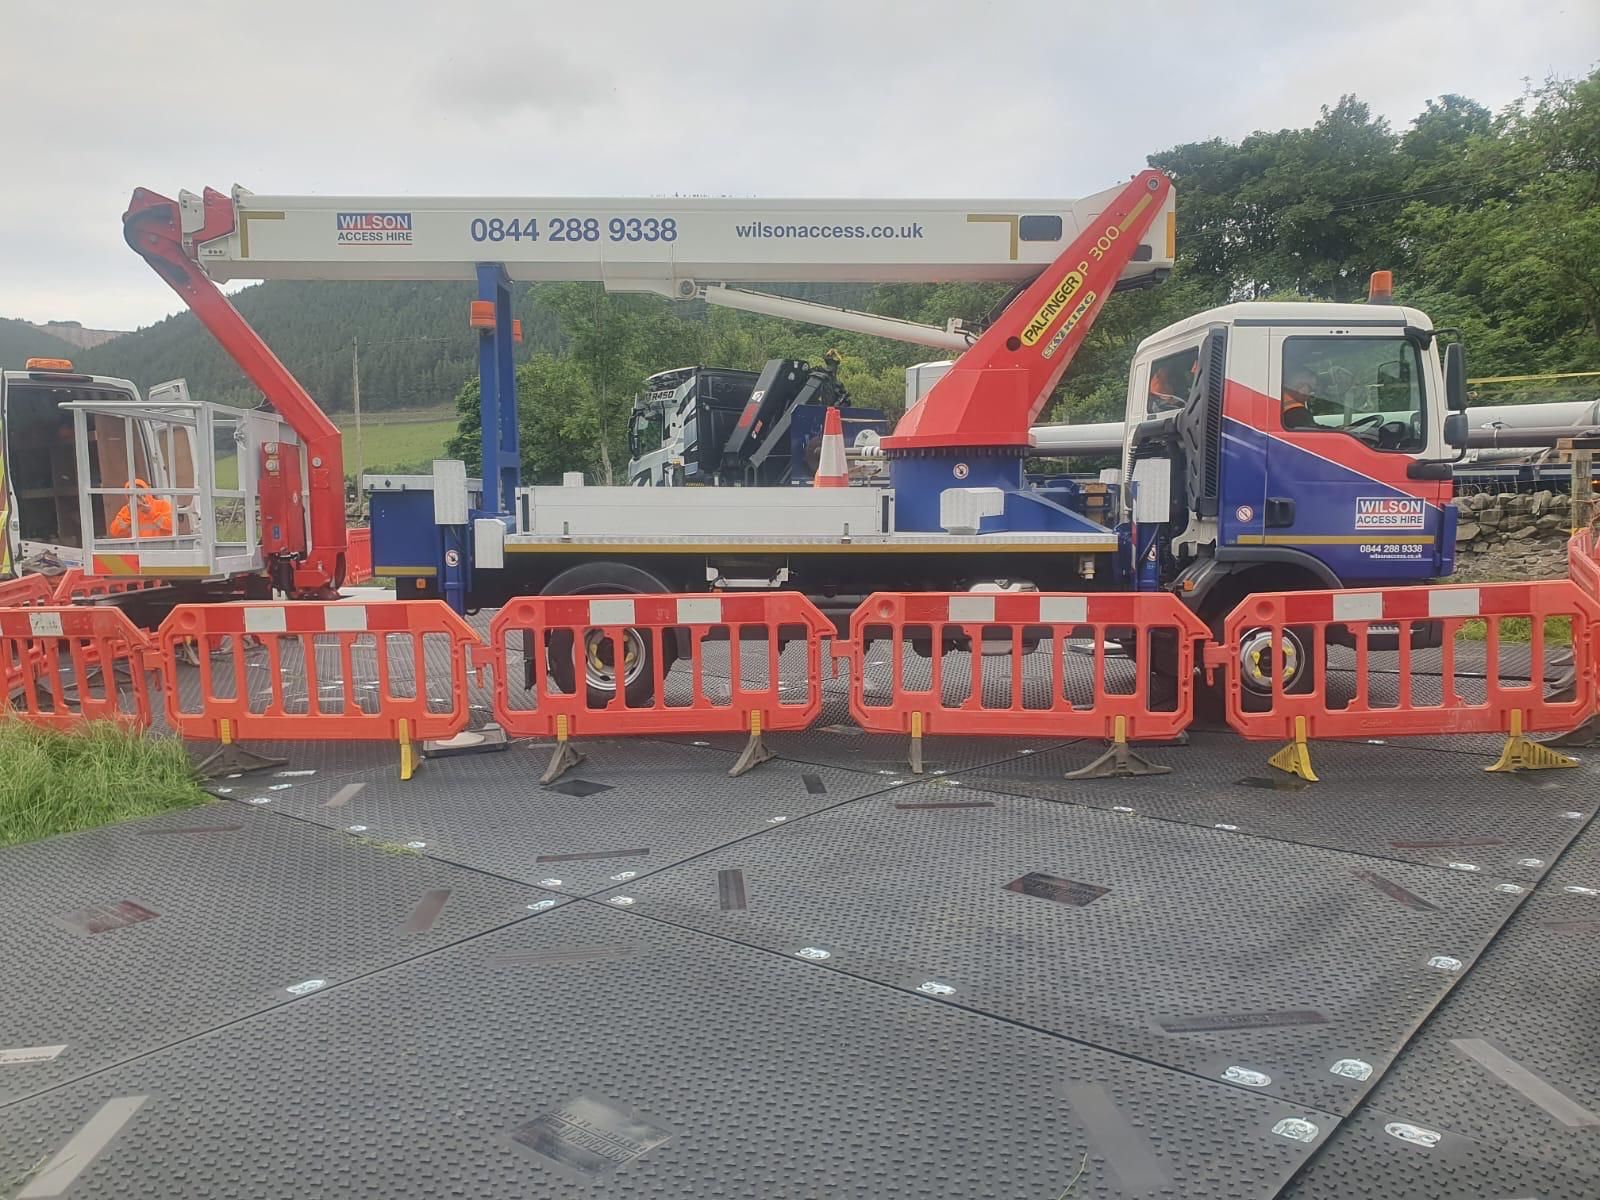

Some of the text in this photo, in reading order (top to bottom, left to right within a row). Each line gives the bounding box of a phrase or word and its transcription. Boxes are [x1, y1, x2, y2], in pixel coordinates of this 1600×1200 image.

[339, 214, 409, 229] WILSON
[471, 217, 678, 242] 0844 288 9338
[735, 222, 923, 238] wilsonaccess.co.uk
[338, 231, 412, 241] ACCESS HIRE
[1024, 225, 1120, 342] PALFINGER P 300
[652, 391, 674, 401] R450
[1360, 500, 1421, 512] WILSON
[1357, 515, 1423, 524] ACCESS HIRE
[1360, 544, 1423, 553] 0844 288 9338
